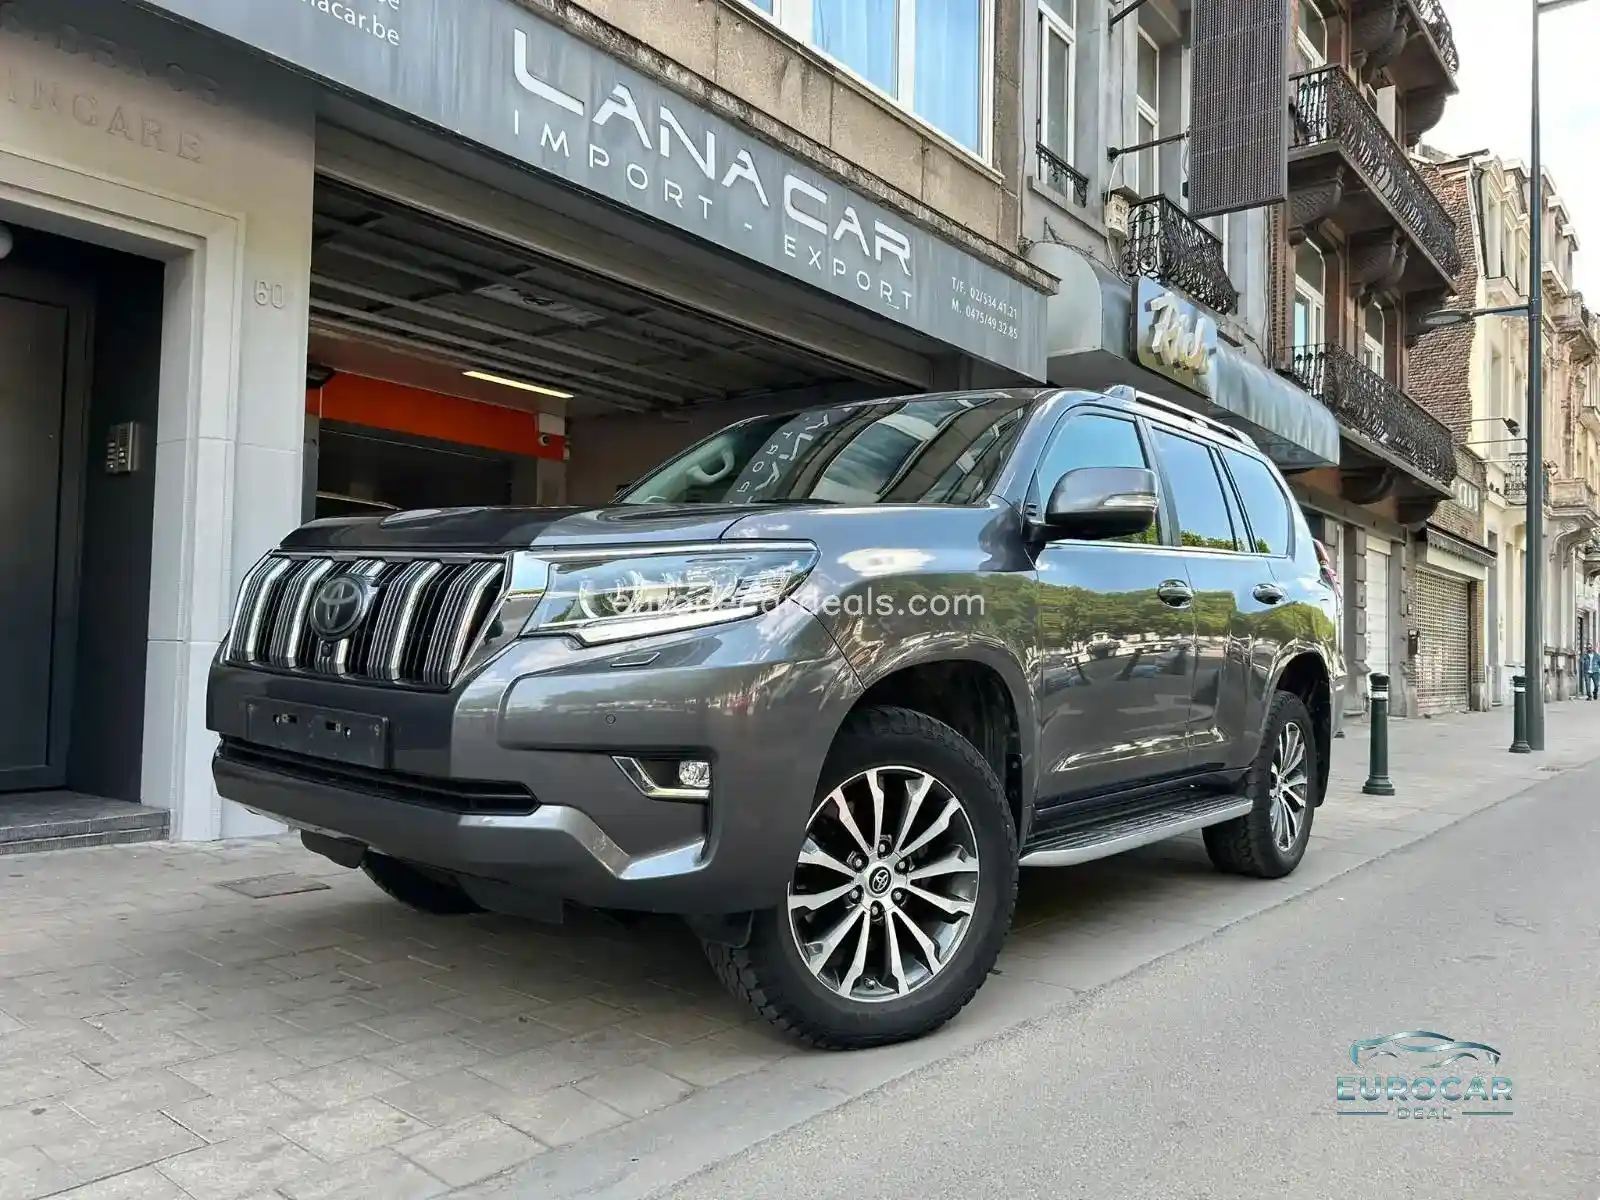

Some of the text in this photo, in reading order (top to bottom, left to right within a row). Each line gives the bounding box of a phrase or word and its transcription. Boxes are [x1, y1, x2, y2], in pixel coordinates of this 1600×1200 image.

[513, 109, 713, 219] IMPORT
[784, 233, 912, 310] EXPORT
[253, 279, 286, 310] 60
